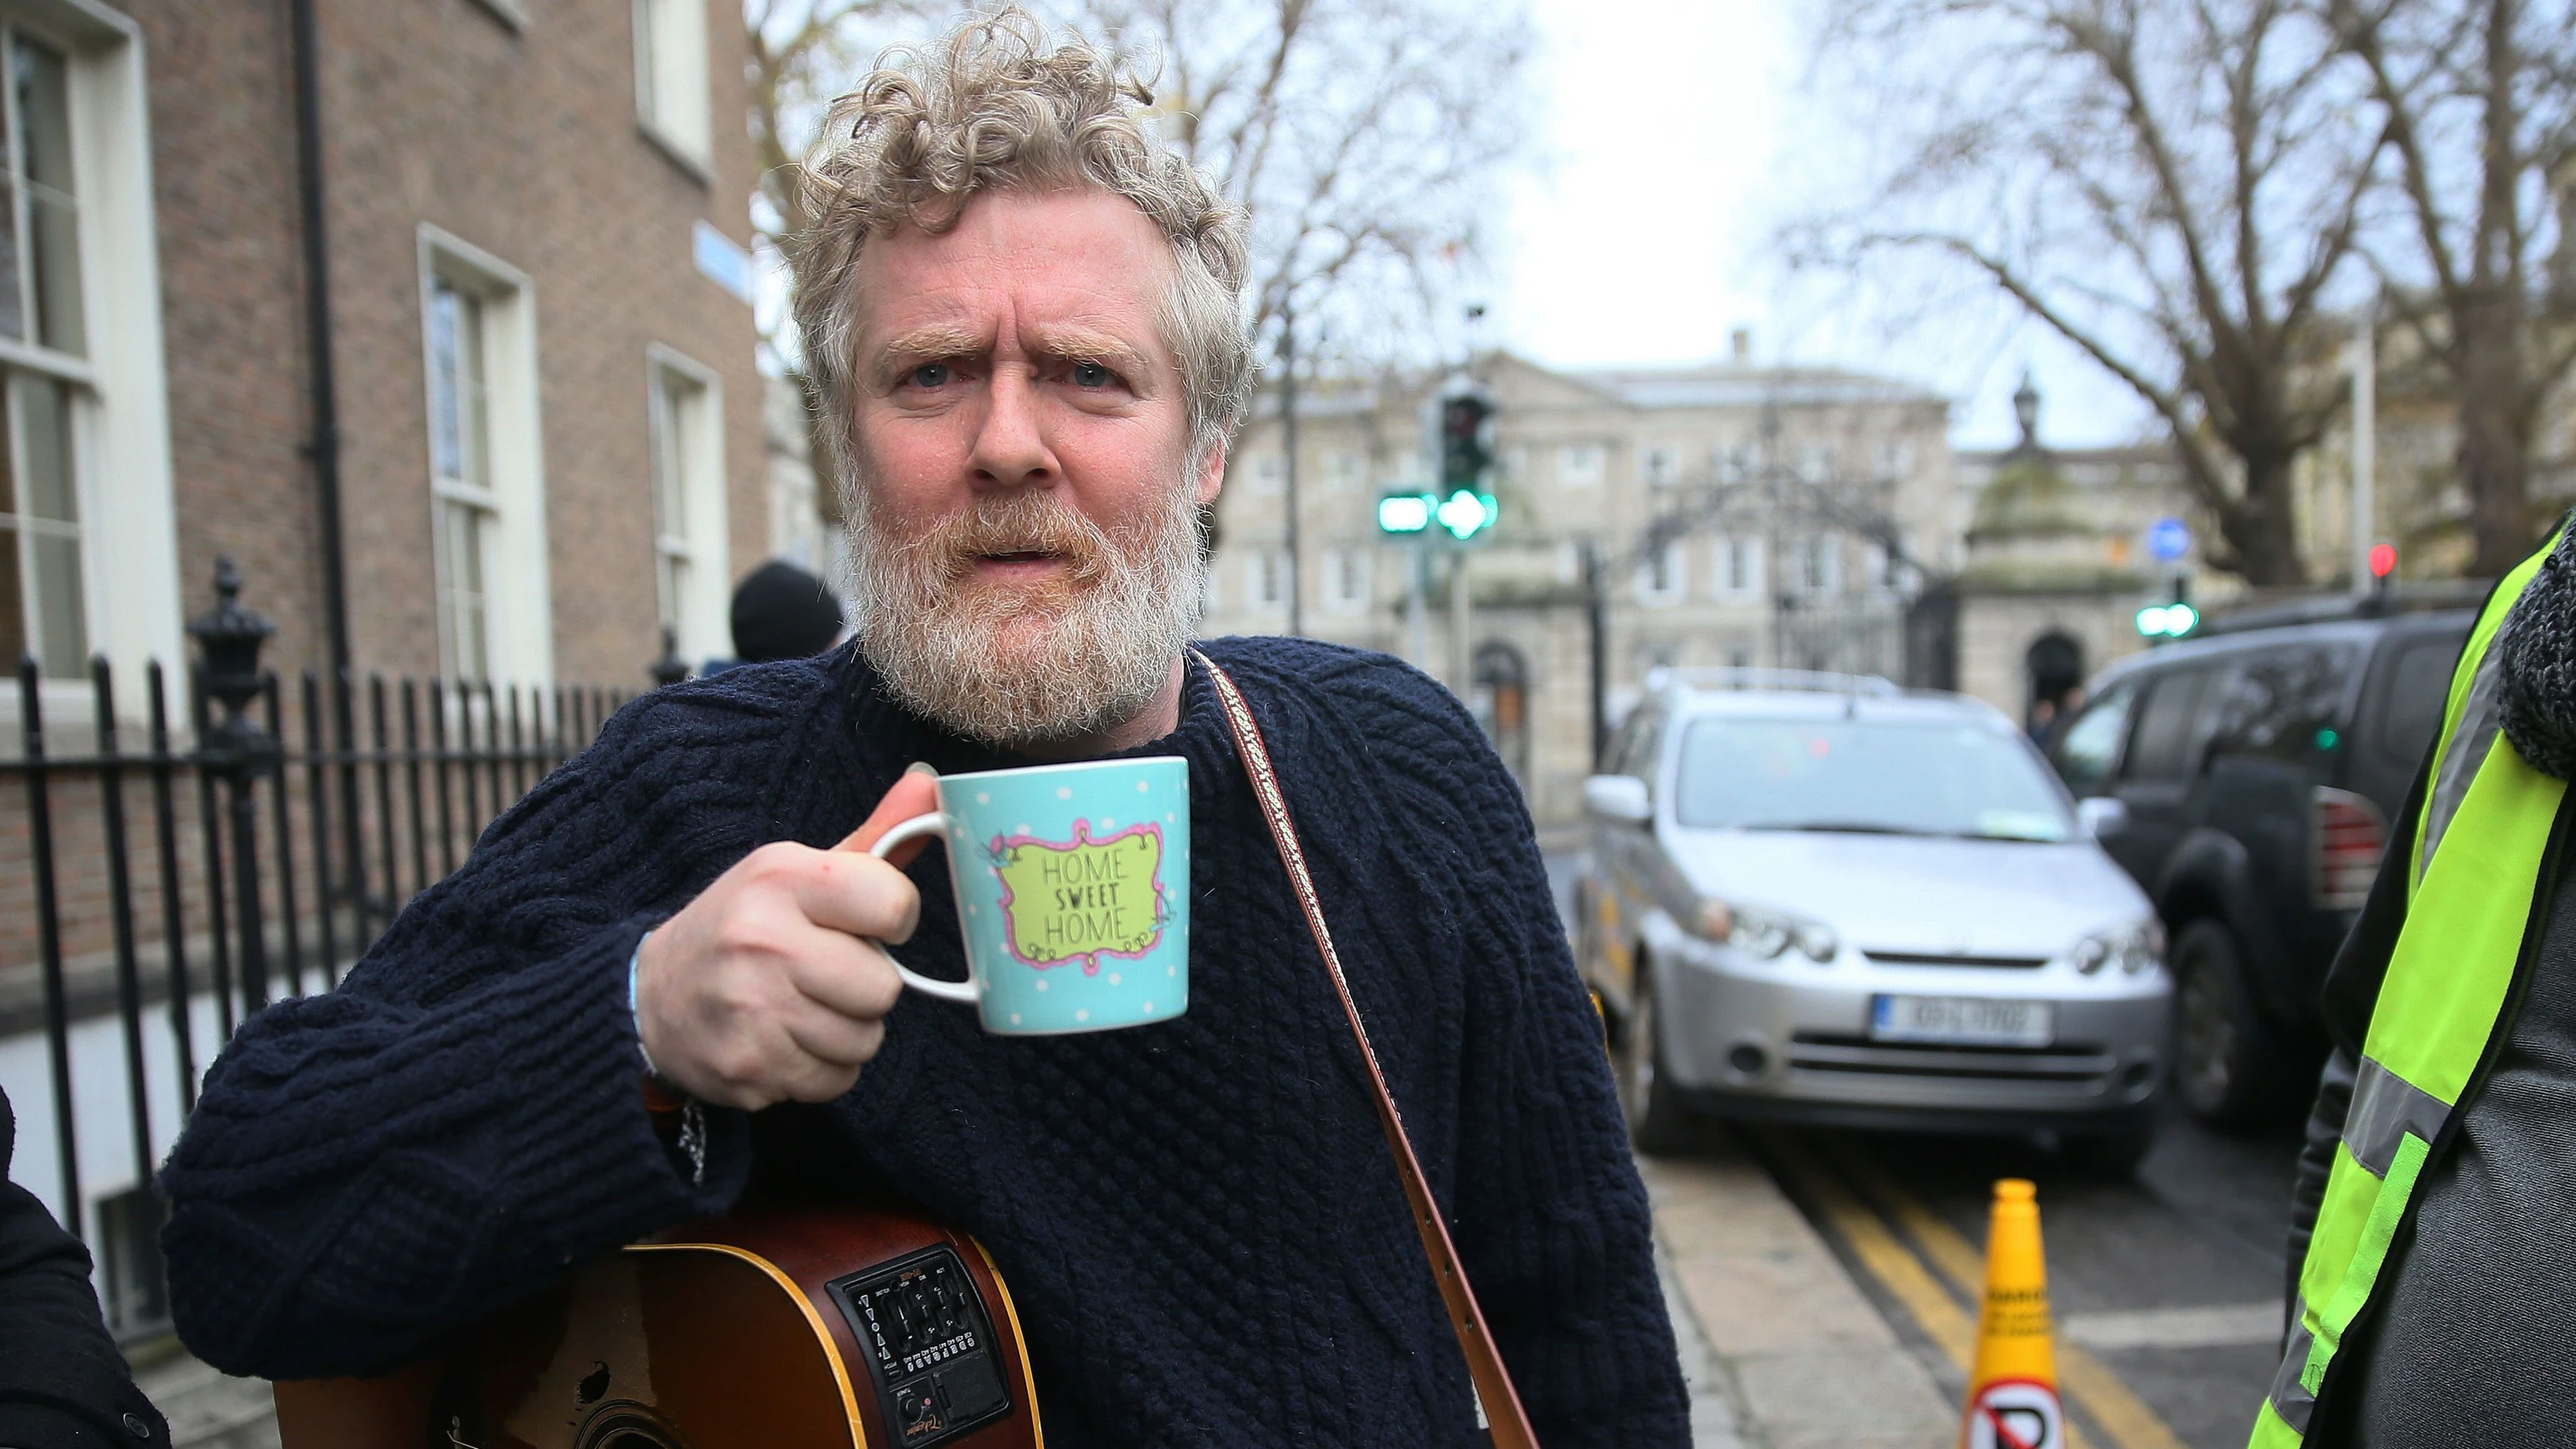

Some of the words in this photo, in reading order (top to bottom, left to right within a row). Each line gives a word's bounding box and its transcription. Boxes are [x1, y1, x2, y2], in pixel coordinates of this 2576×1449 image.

[1042, 849, 1128, 883] HOME
[1055, 882, 1119, 910] SWEET
[1044, 906, 1128, 944] HOME
